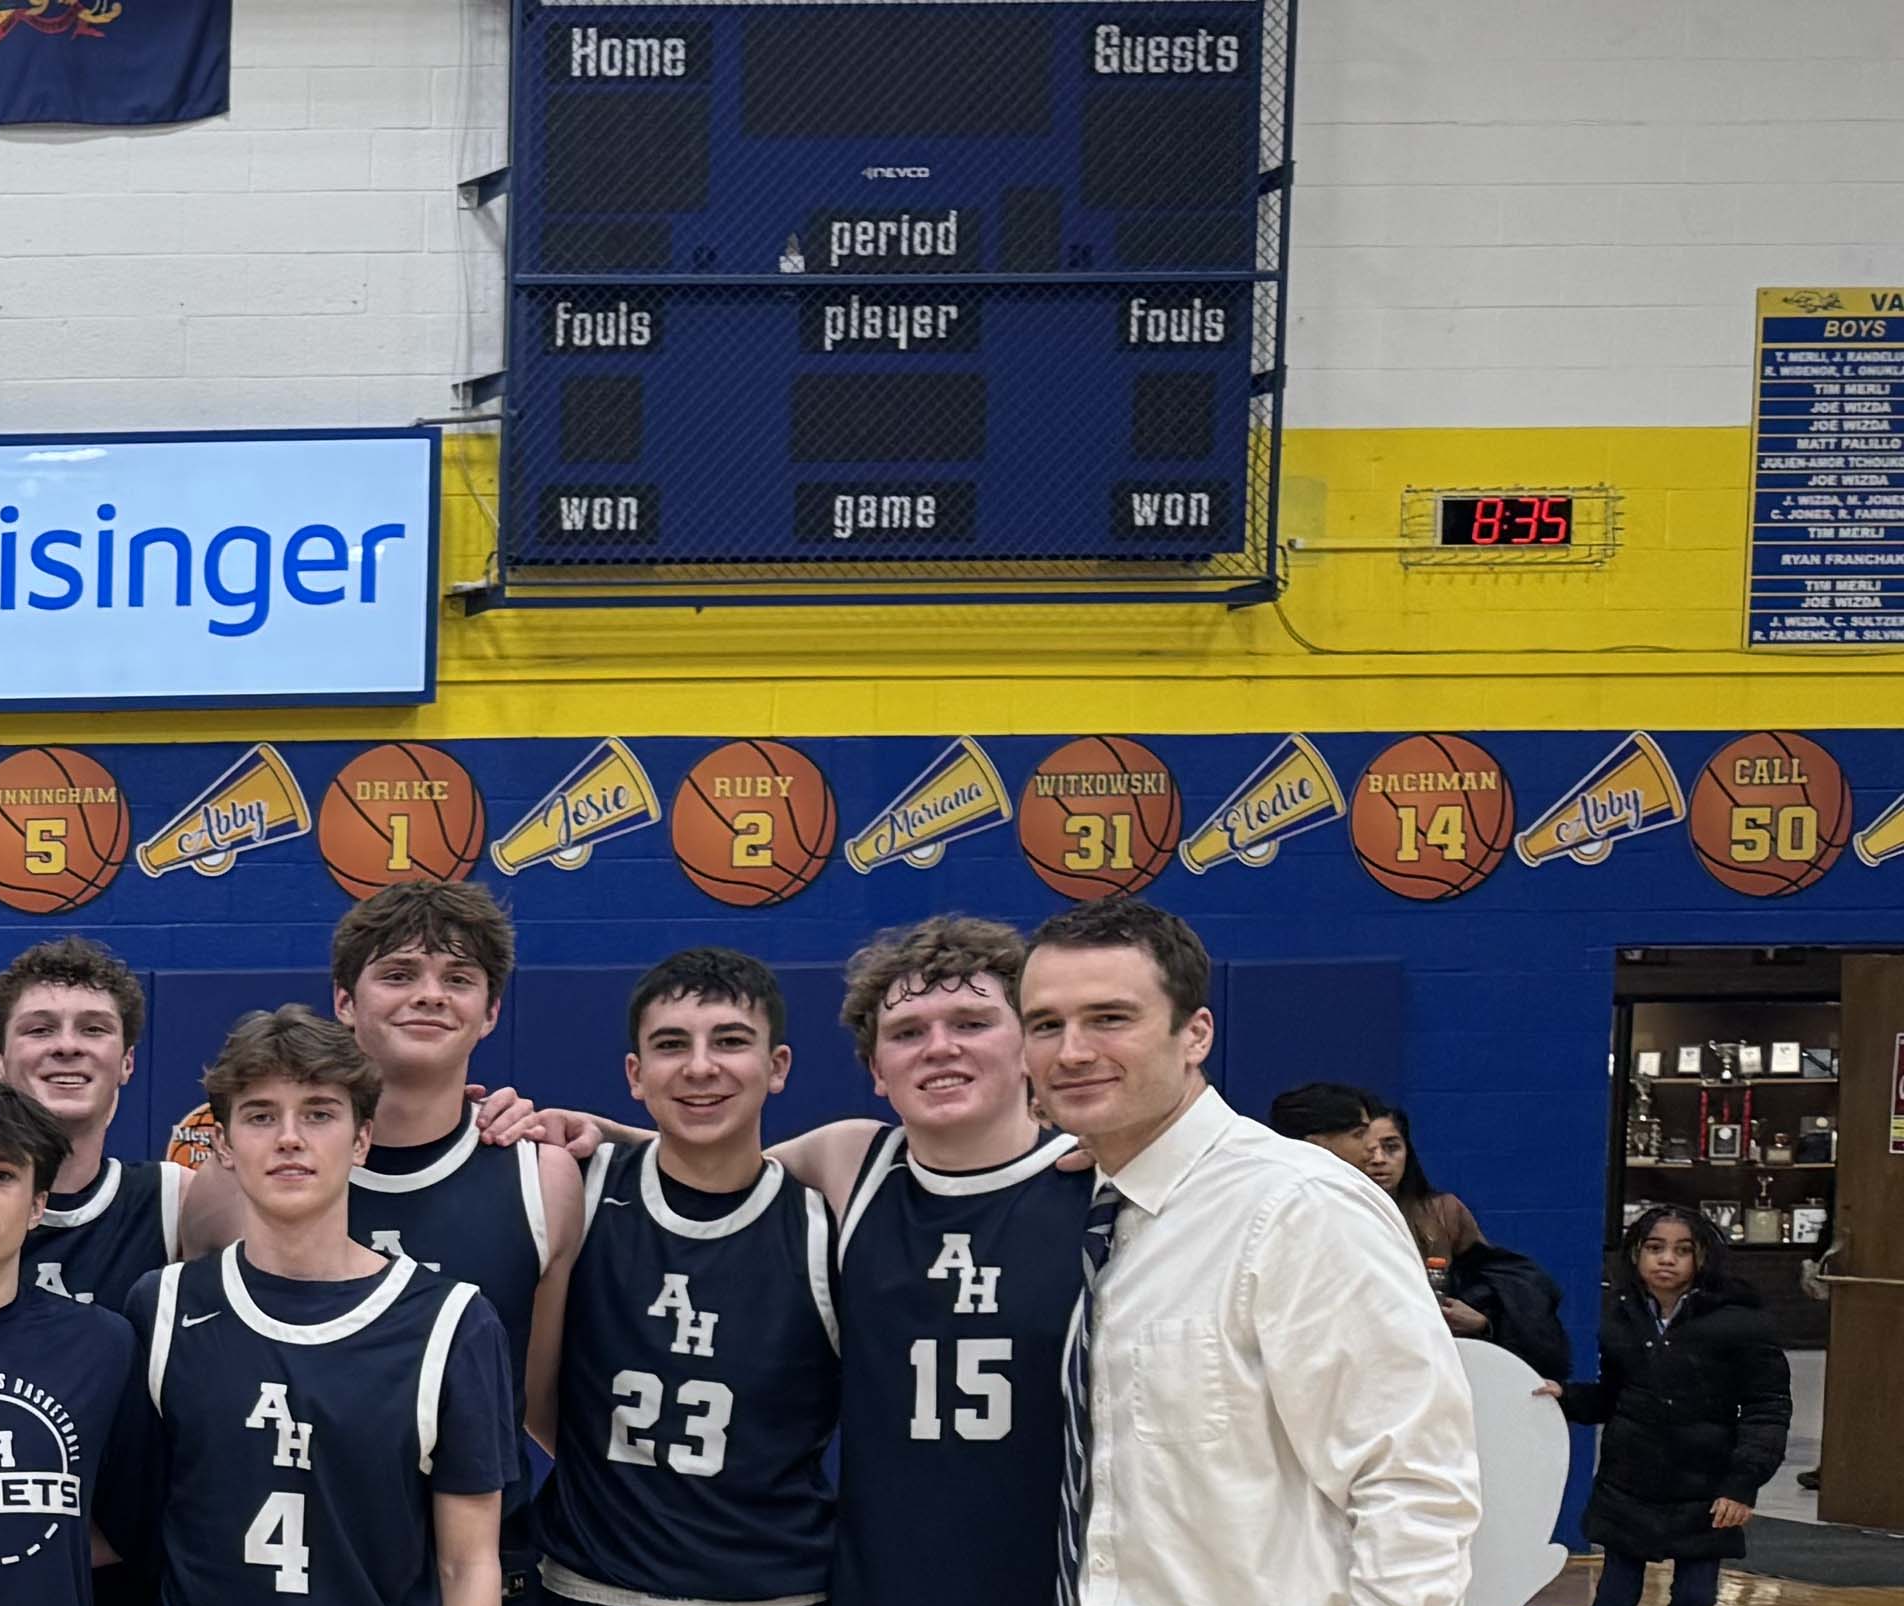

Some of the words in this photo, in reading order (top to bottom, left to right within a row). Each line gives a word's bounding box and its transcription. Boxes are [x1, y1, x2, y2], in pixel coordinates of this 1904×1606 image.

[571, 28, 686, 78] Home
[1095, 24, 1239, 75] Guests
[830, 210, 958, 267] period
[555, 302, 652, 348] fouls
[824, 296, 958, 350] player
[1129, 298, 1225, 345] fouls
[1824, 320, 1886, 337] BOYS
[560, 493, 638, 531] won
[833, 491, 936, 540] game
[1132, 489, 1210, 529] won
[1472, 498, 1567, 543] 8:35
[356, 779, 449, 802] DRAKE
[713, 774, 793, 799] RUBY
[1035, 771, 1167, 797] WITKOWSKI
[1368, 769, 1498, 794] BACHMAN
[1733, 757, 1809, 785] CALL
[178, 798, 268, 858] Abby
[543, 783, 629, 848] Josie
[732, 812, 773, 868] 2
[872, 780, 984, 858] Mariana
[1216, 774, 1314, 853] Elodie
[1395, 804, 1468, 862] 14
[1554, 785, 1644, 847] Abby
[1729, 804, 1818, 863] 50
[24, 818, 68, 874] 5
[386, 814, 412, 871] 1
[1063, 812, 1136, 871] 31
[909, 1338, 1013, 1441] 15
[607, 1370, 734, 1477] 23
[243, 1493, 310, 1594] 4
